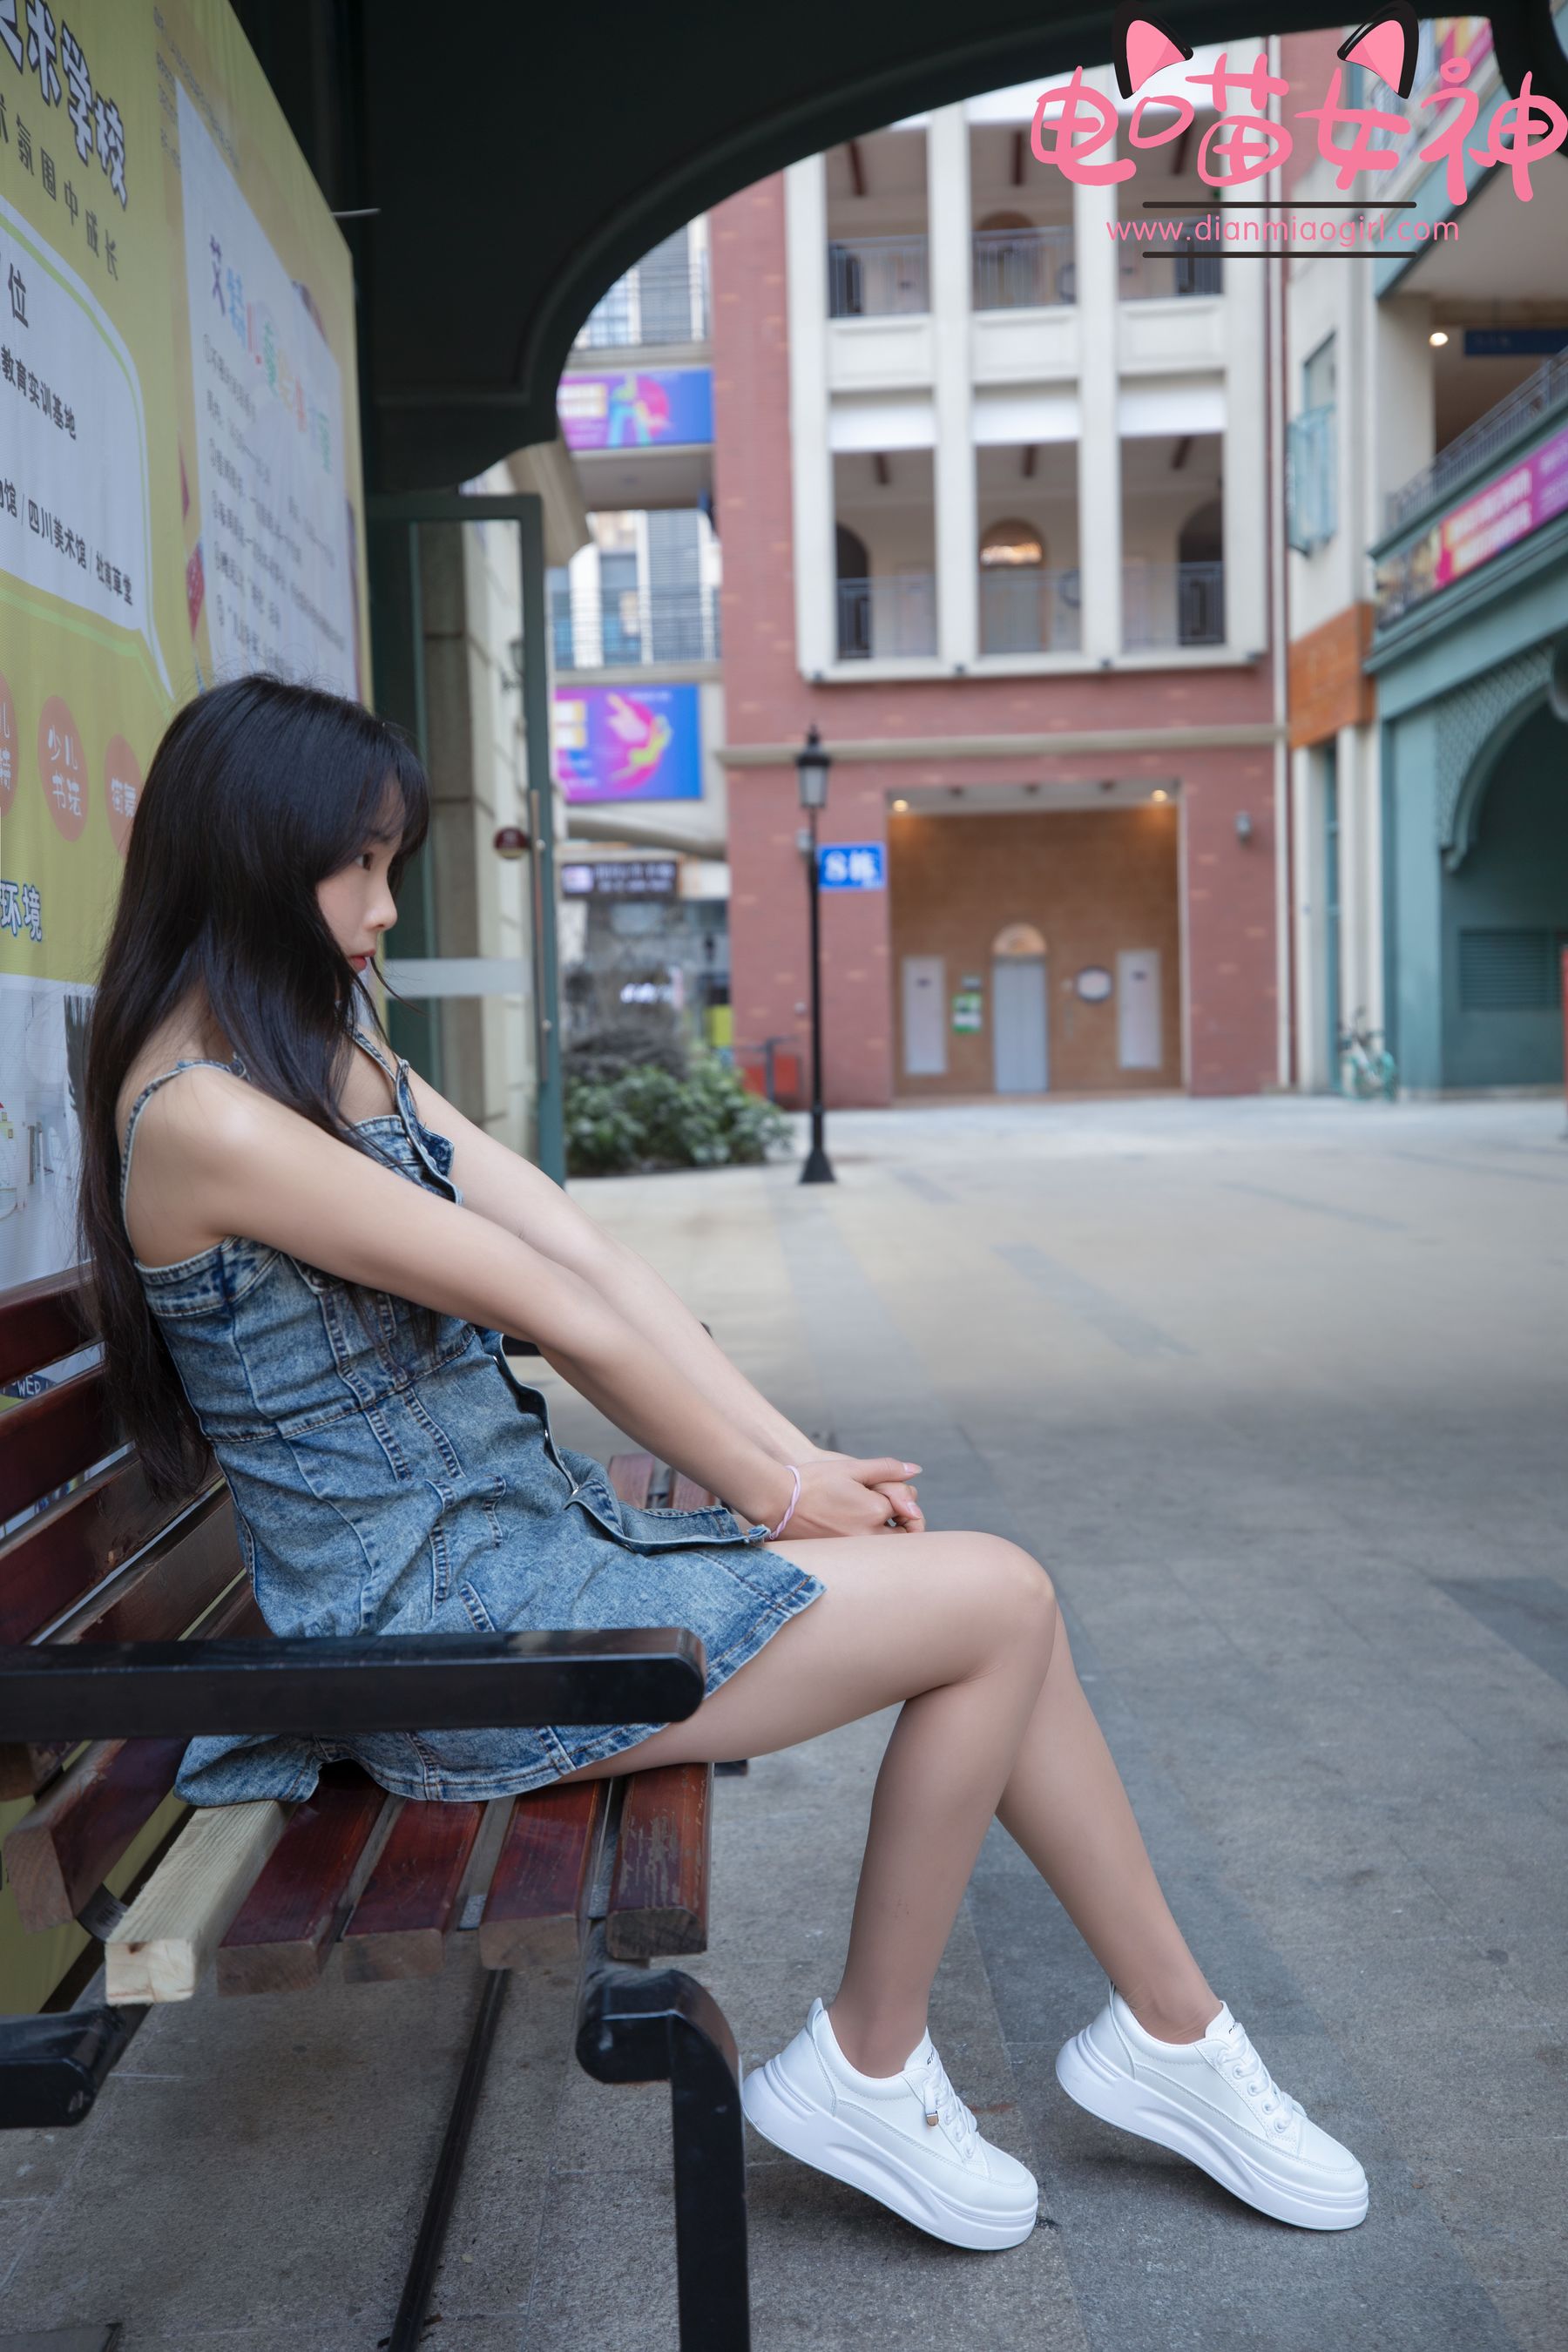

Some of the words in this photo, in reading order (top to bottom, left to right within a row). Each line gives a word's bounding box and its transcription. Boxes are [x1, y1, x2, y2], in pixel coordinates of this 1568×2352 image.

[0, 0, 127, 211] 术学校
[8, 262, 29, 328] 位
[28, 498, 86, 570] 四川美术馆
[48, 724, 78, 770] 少儿
